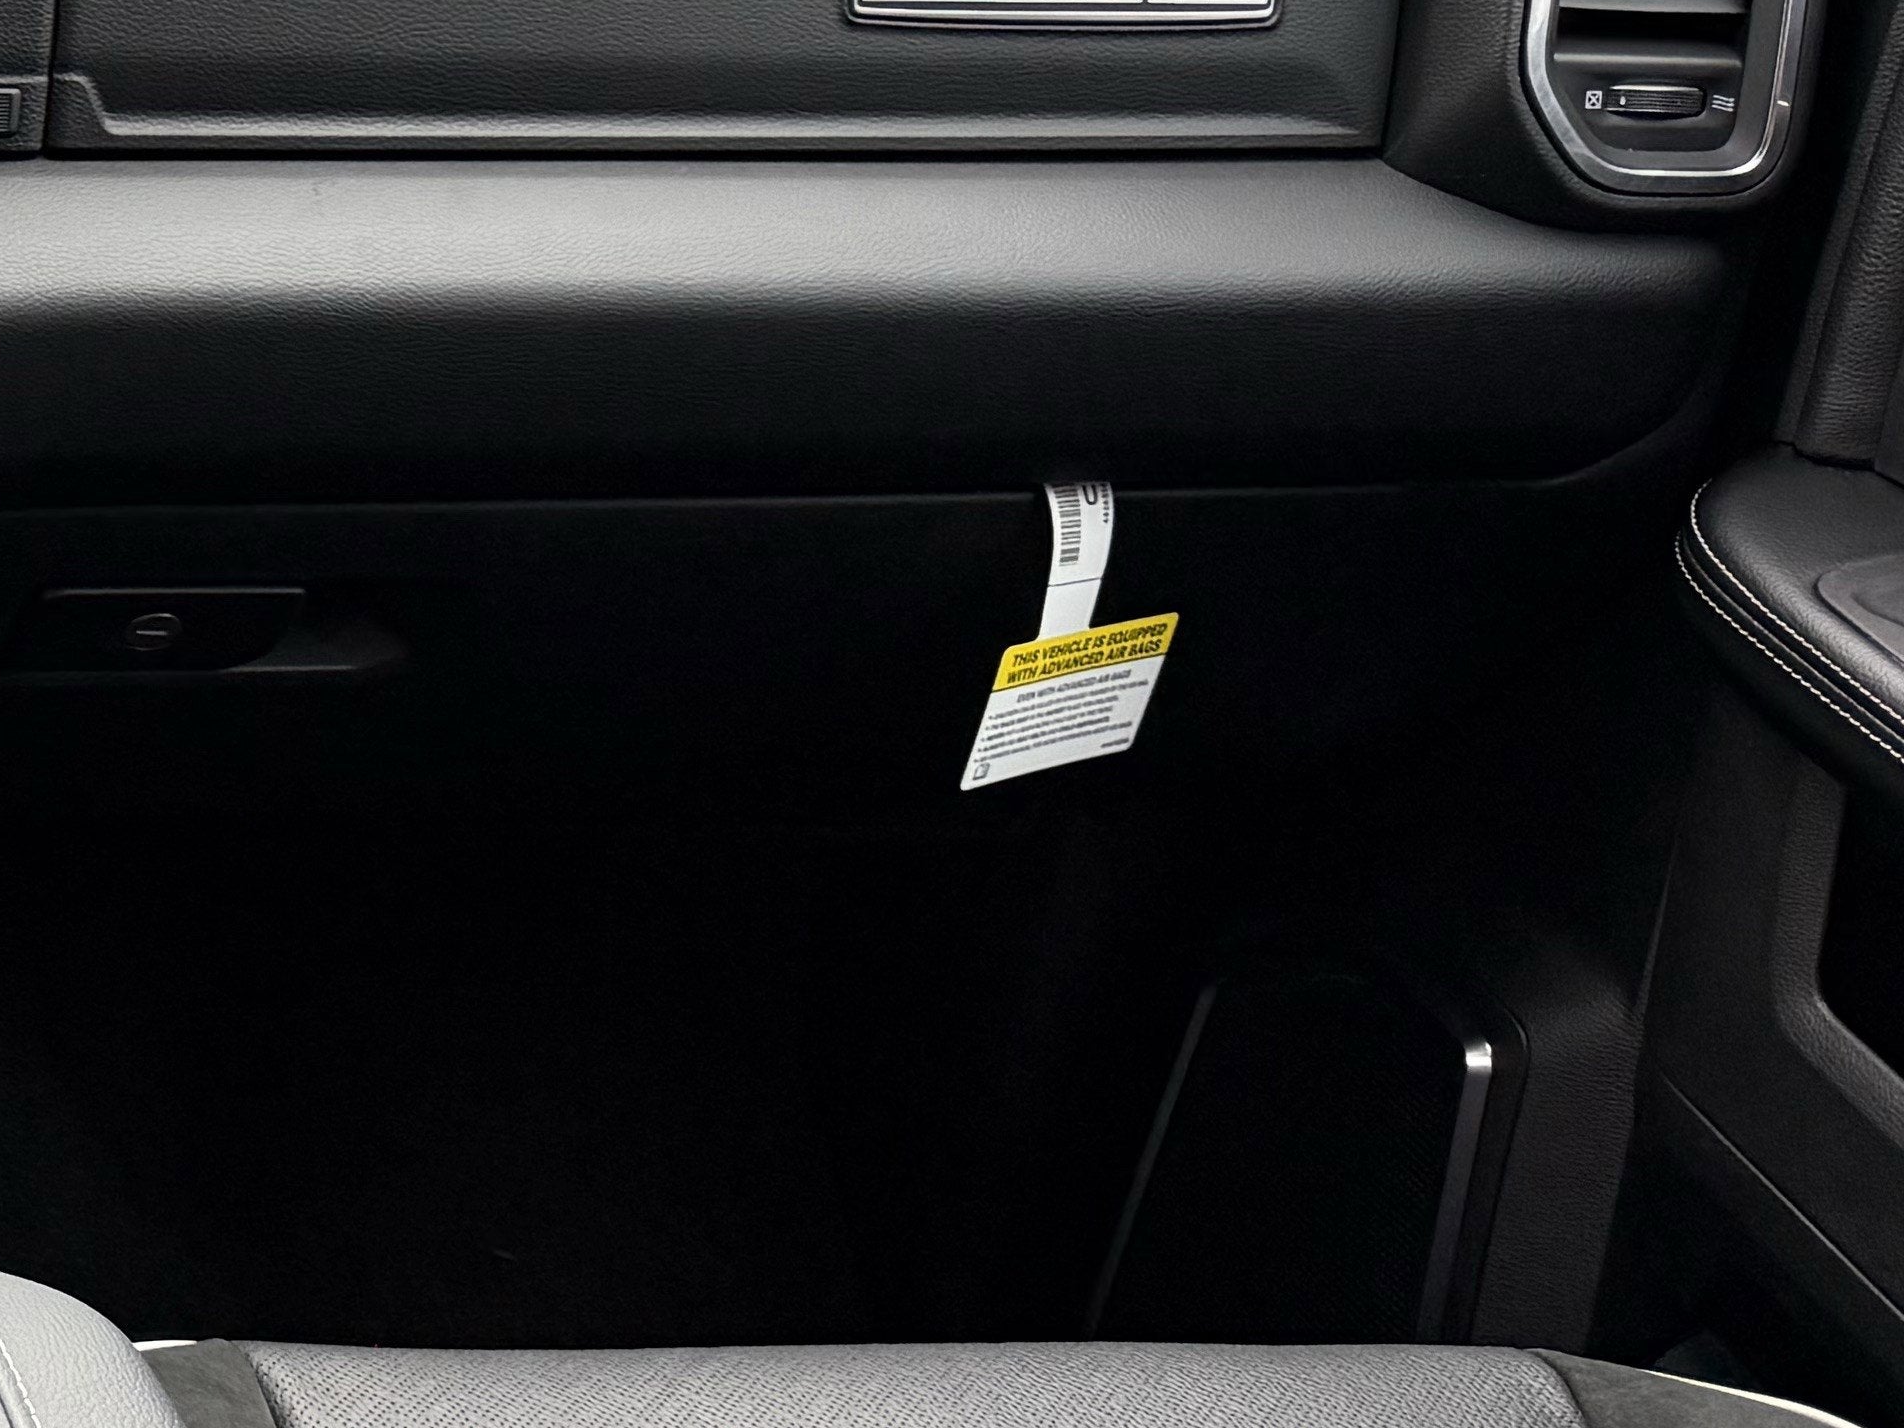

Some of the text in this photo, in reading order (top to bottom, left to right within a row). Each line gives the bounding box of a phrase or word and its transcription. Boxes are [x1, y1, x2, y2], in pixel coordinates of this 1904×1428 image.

[1007, 639, 1162, 684] WITH ADVANCED AIR BAGS
[1011, 623, 1168, 668] THIS VEHICLE IS EQUIPPED
